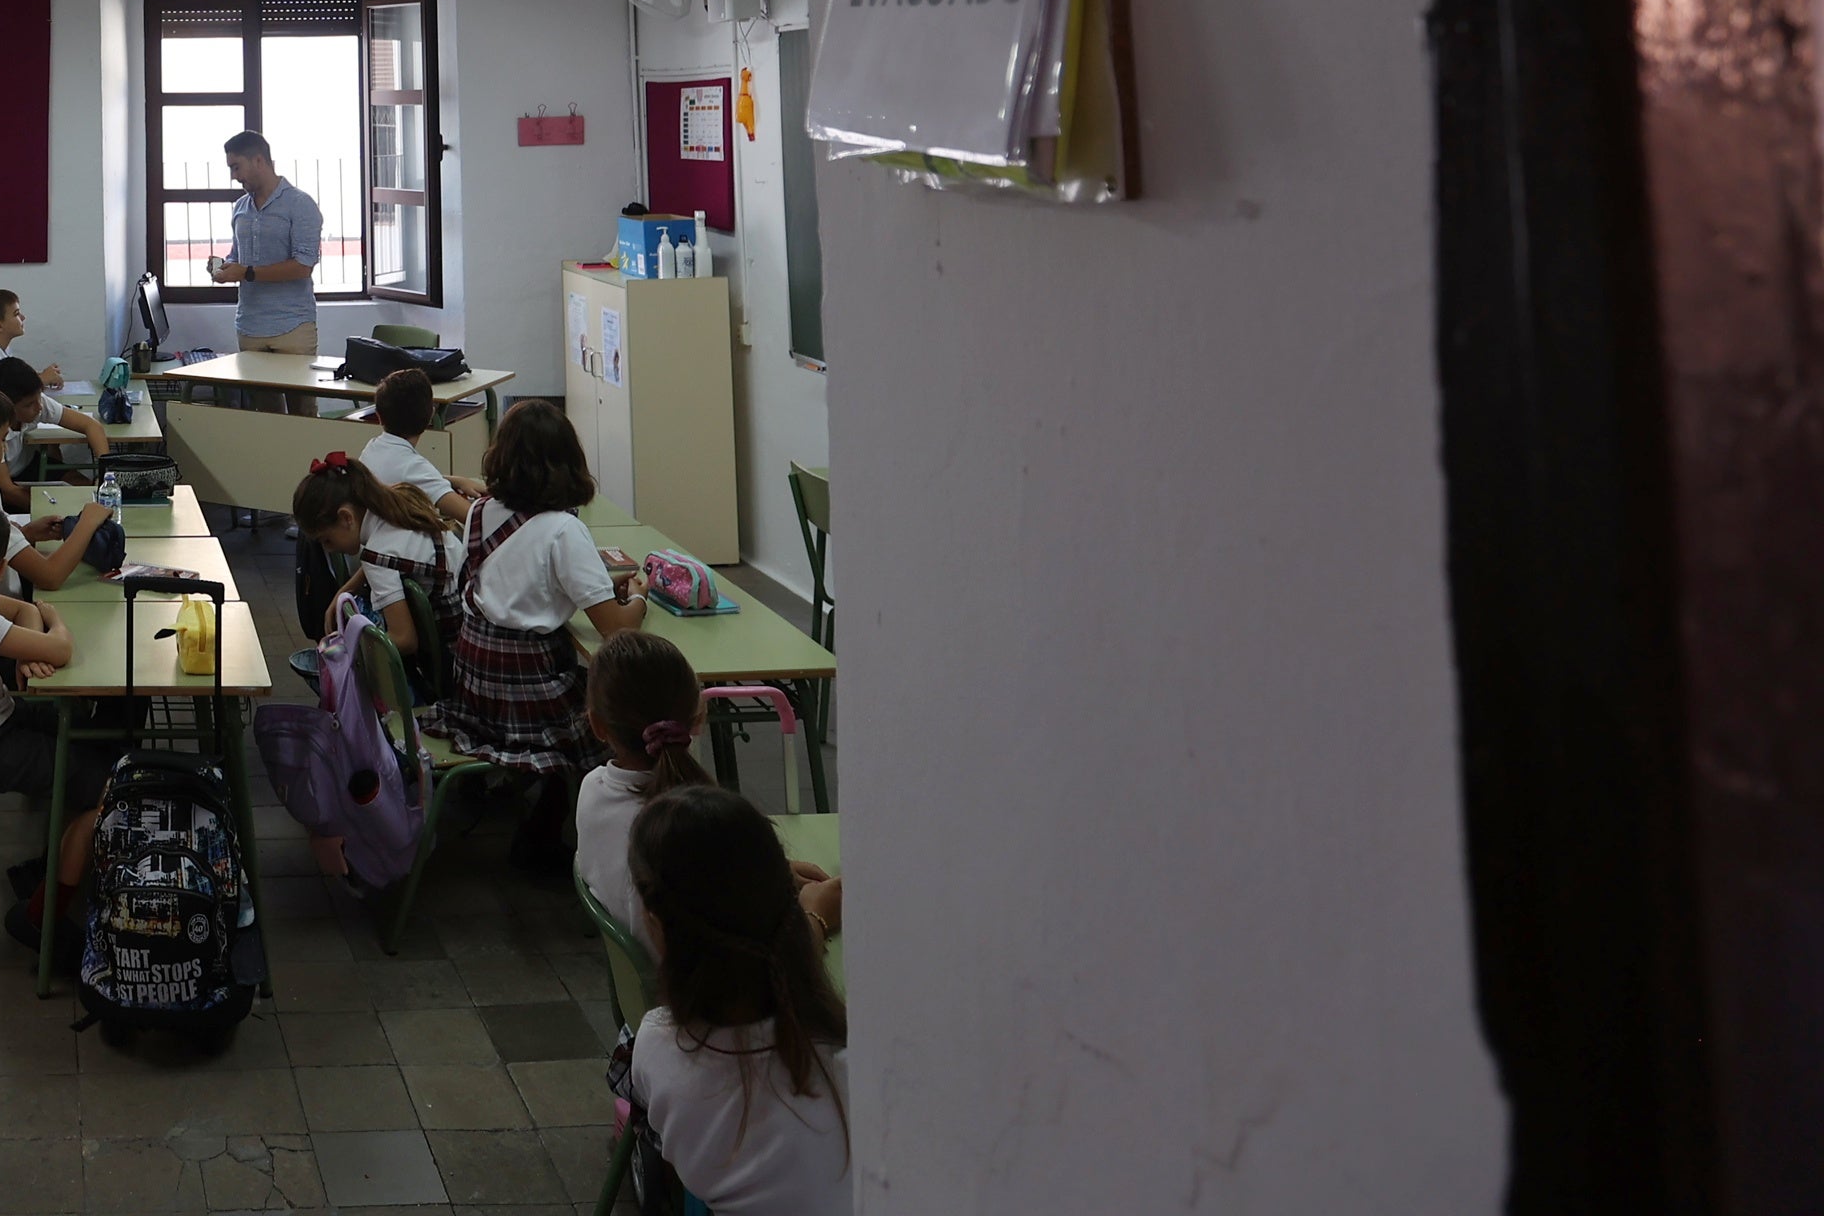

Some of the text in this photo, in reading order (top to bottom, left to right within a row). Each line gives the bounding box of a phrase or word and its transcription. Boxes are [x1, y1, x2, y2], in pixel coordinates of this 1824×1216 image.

[113, 945, 151, 969] TART
[122, 969, 151, 983] WHAT
[151, 958, 203, 984] STOPS
[136, 978, 198, 1005] PEOPLE
